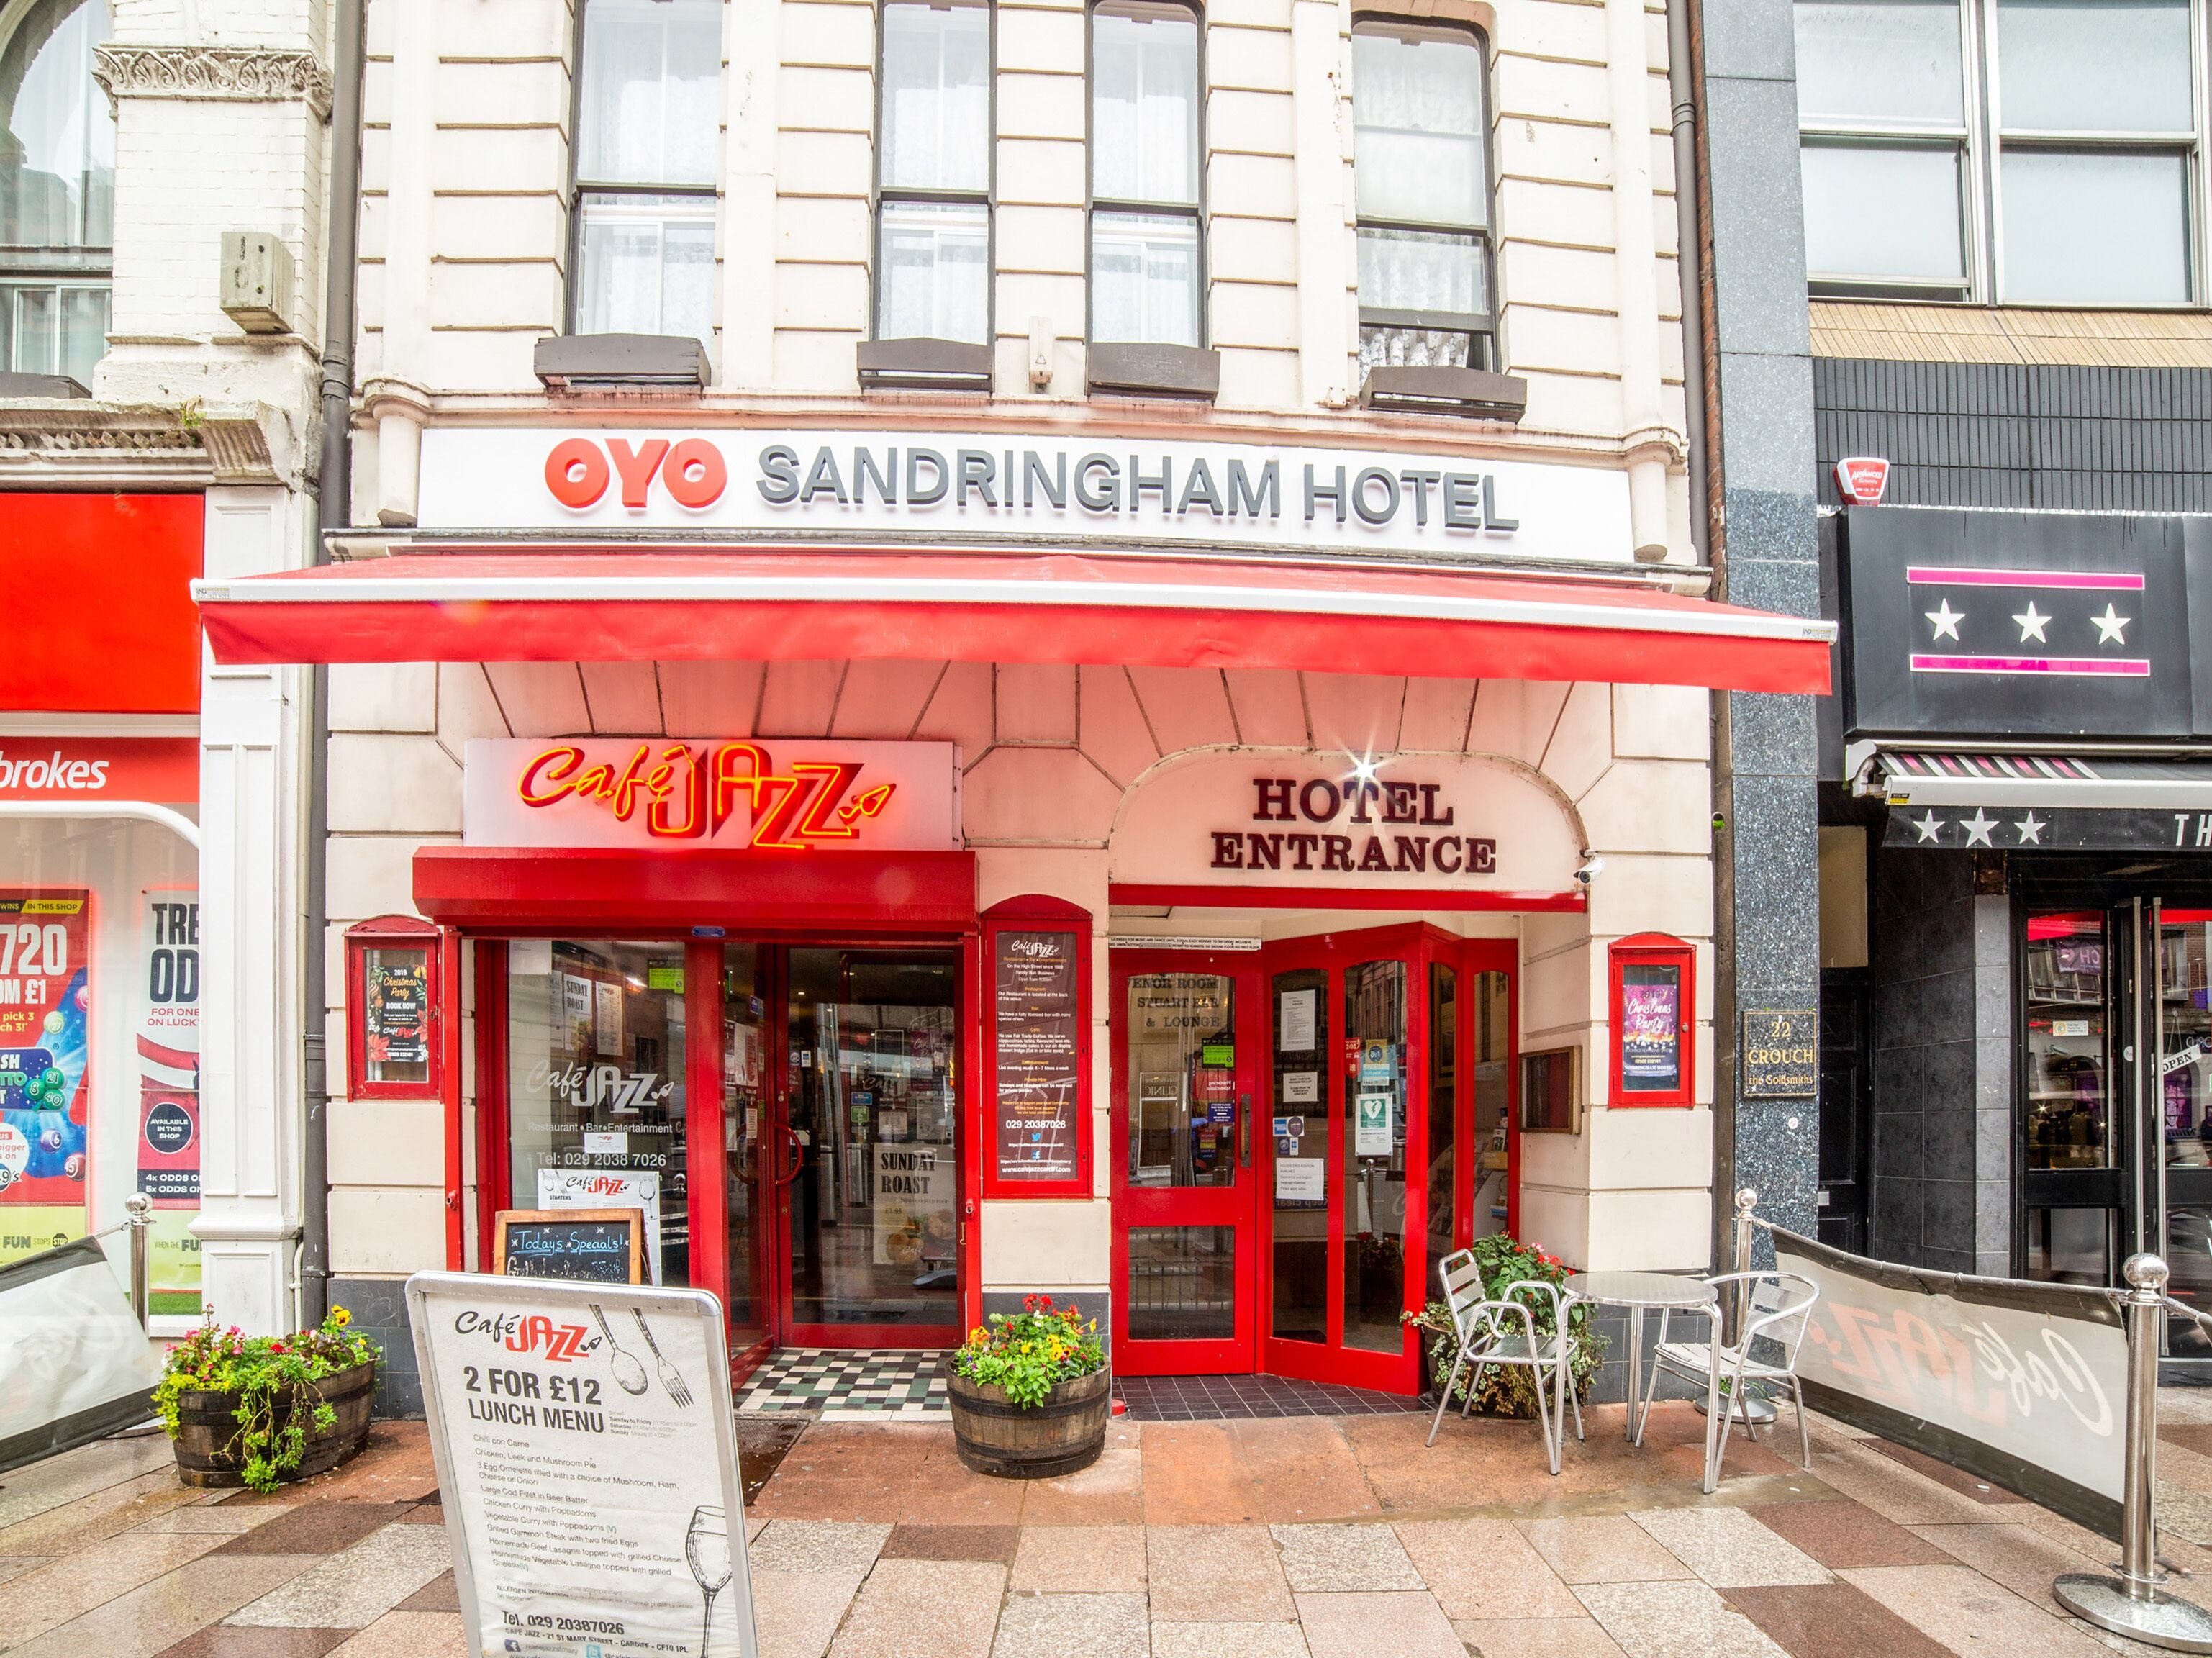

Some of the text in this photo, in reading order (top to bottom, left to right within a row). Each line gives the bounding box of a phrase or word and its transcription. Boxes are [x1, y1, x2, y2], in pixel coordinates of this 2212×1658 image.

[545, 438, 1519, 533] OYO SANDRINGHAM HOTEL
[518, 744, 865, 849] Café JAZZ
[1253, 779, 1454, 826] HOTEL
[1210, 832, 1496, 874] ENTRANCE
[1011, 940, 1055, 958] Café JAZZ
[384, 977, 417, 987] Christmas
[566, 980, 588, 997] SUNDAY
[1128, 978, 1218, 989] ENOR ROOM
[25, 979, 46, 1004] £1
[391, 987, 410, 1001] Party
[1138, 997, 1219, 1007] STUART BAR
[1628, 998, 1672, 1015] Christmas
[3, 1011, 34, 1023] pick 3
[1146, 1017, 1219, 1027] & LOUNGE
[1635, 1014, 1664, 1034] Party
[1770, 1021, 1791, 1038] 22
[1748, 1048, 1813, 1065] CROUCH
[2162, 1052, 2193, 1072] OPEN
[47, 1072, 58, 1084] 21
[526, 1059, 658, 1114] Café JAZZ
[1749, 1074, 1813, 1085] the Goldsmiths
[30, 1082, 39, 1095] 8
[44, 1092, 62, 1106] 40
[528, 1123, 672, 1133] Restaurant Bar Entertainment
[1006, 1120, 1066, 1128] 029 20387026
[537, 1152, 666, 1167] Tel: 029 2038 7026
[881, 1152, 935, 1172] SUNDAY
[566, 1177, 595, 1190] Café
[588, 1176, 624, 1195] JAZZ
[881, 1175, 930, 1194] ROAST
[3, 1236, 31, 1249] FUN
[53, 1237, 68, 1246] STOP
[570, 1231, 623, 1256] Specials!
[455, 1311, 589, 1362] Café JAZZ
[463, 1366, 602, 1405] 2 FOR £12
[468, 1398, 604, 1433] LUNCH MENU
[473, 1433, 490, 1443] Chilli
[507, 1439, 530, 1448] Carne
[475, 1447, 506, 1459] Chicken,
[507, 1453, 525, 1462] Leek
[543, 1456, 582, 1467] Mushroom
[584, 1460, 596, 1469] Pie
[481, 1485, 501, 1495] Large
[502, 1487, 517, 1497] Cod
[519, 1490, 536, 1498] Fillet
[546, 1493, 563, 1502] Beer
[484, 1510, 519, 1523] Vegetable
[520, 1516, 540, 1526] Curry
[560, 1521, 604, 1531] Poppadoms
[606, 1525, 617, 1534] (V)
[487, 1523, 509, 1534] Grilled
[510, 1528, 544, 1538] Gammon
[546, 1531, 566, 1541] Steak
[620, 1539, 639, 1548] Eggs
[501, 1610, 625, 1635] Tel. 029 20387026
[524, 1629, 540, 1638] JAZZ
[589, 1636, 613, 1646] STREET
[620, 1640, 650, 1649] CARDIFF
